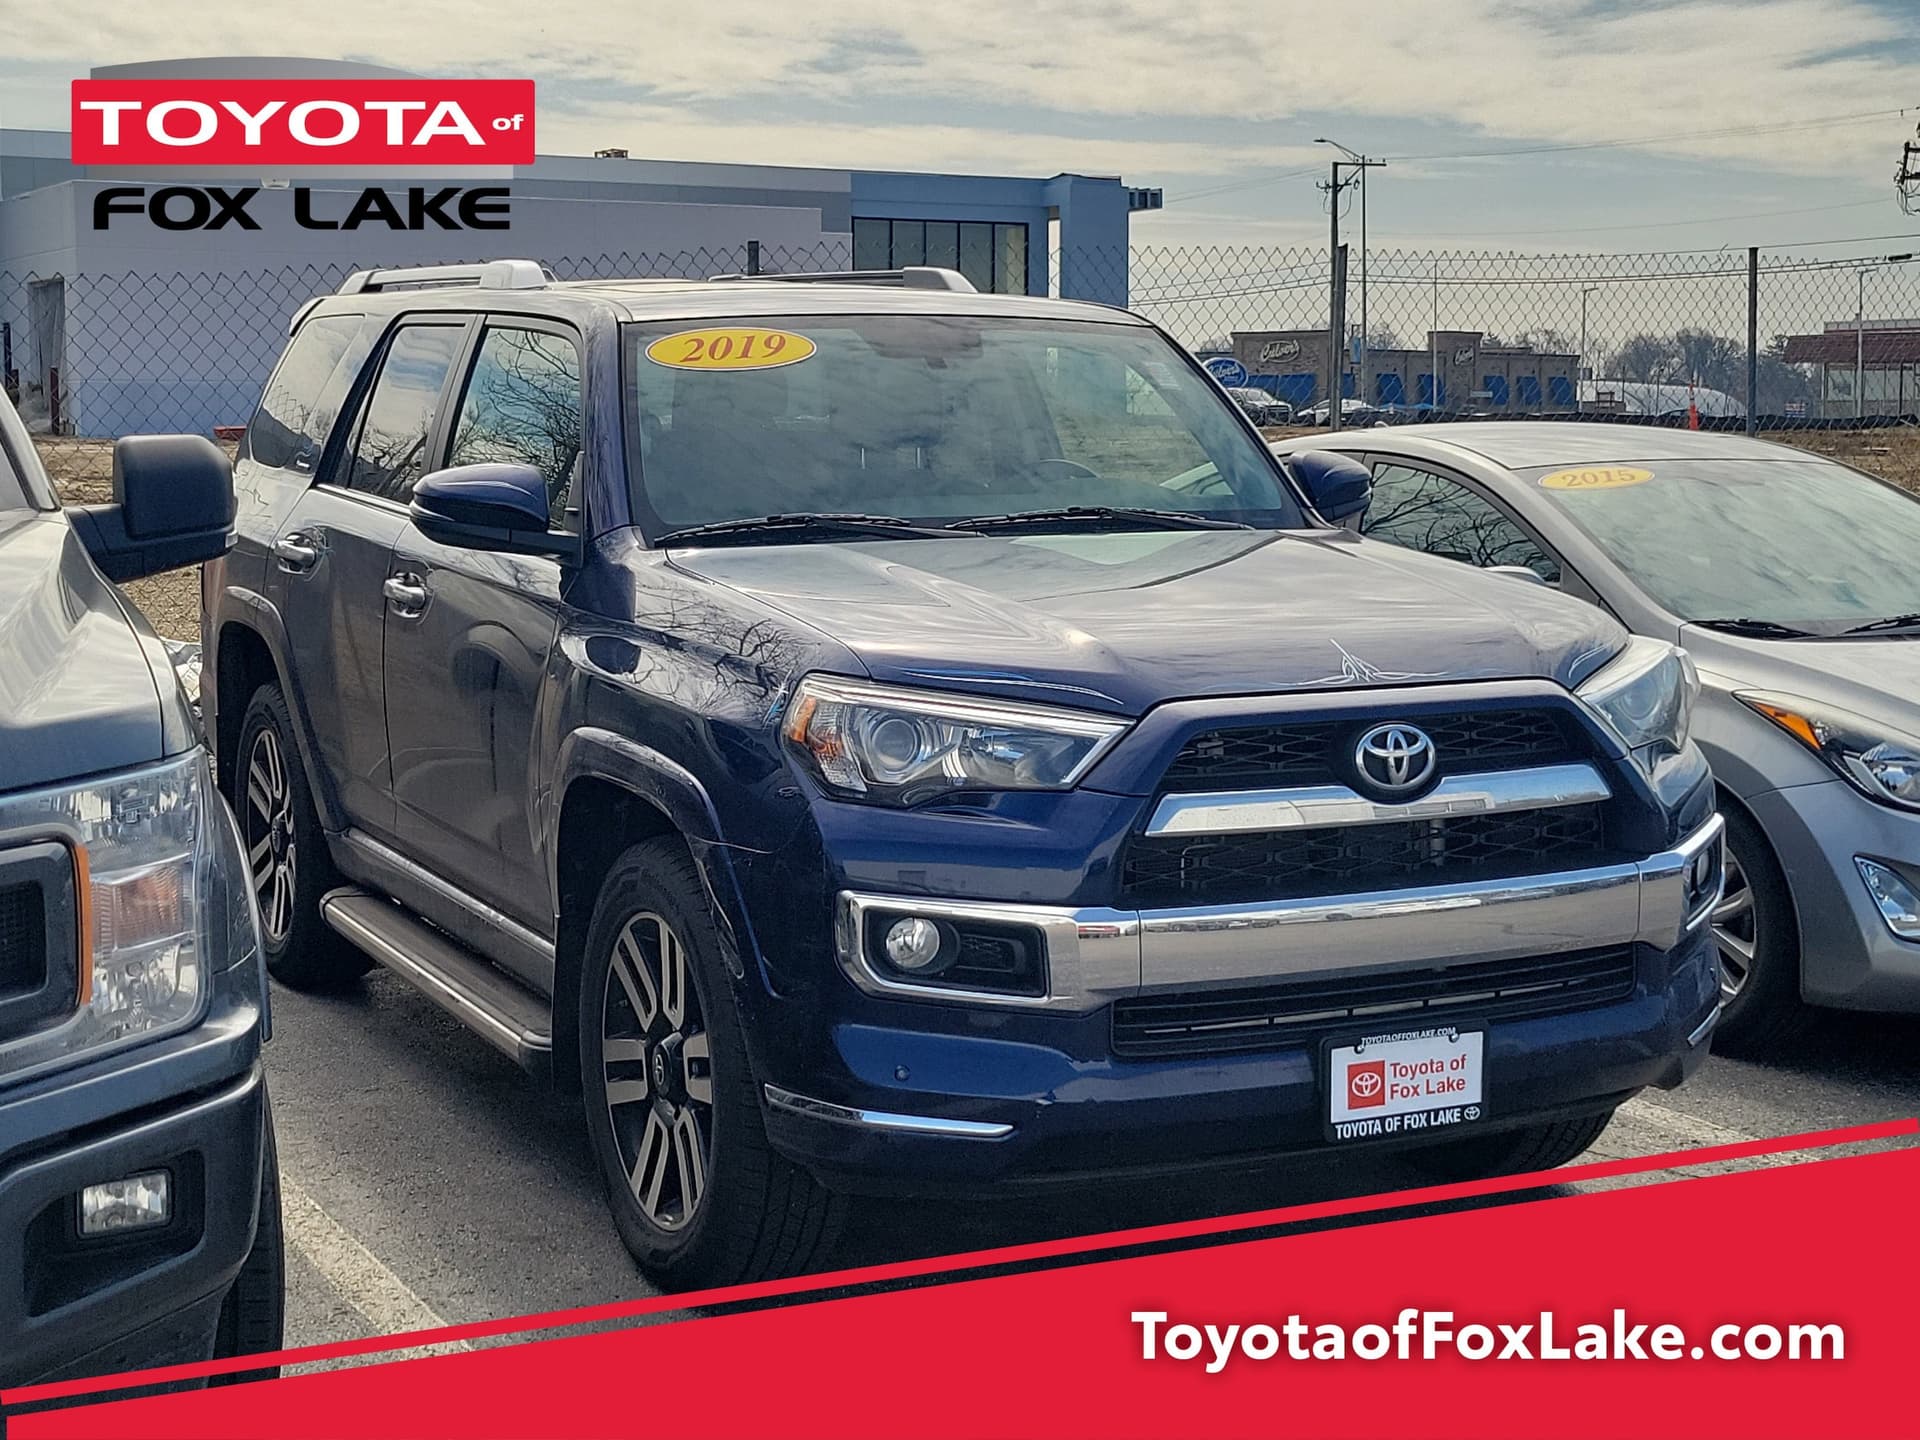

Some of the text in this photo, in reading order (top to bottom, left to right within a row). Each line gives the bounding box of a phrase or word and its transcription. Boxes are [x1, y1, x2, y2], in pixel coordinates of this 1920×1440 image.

[679, 334, 787, 363] 2019
[1562, 469, 1636, 487] 2015
[1361, 1027, 1456, 1047] TOYOTAOFFOXLAKE.COM
[1390, 1054, 1467, 1080] Toyota of
[1390, 1077, 1466, 1100] Fox Lake
[1335, 1107, 1461, 1140] TOYOTA OF FOX LAKE
